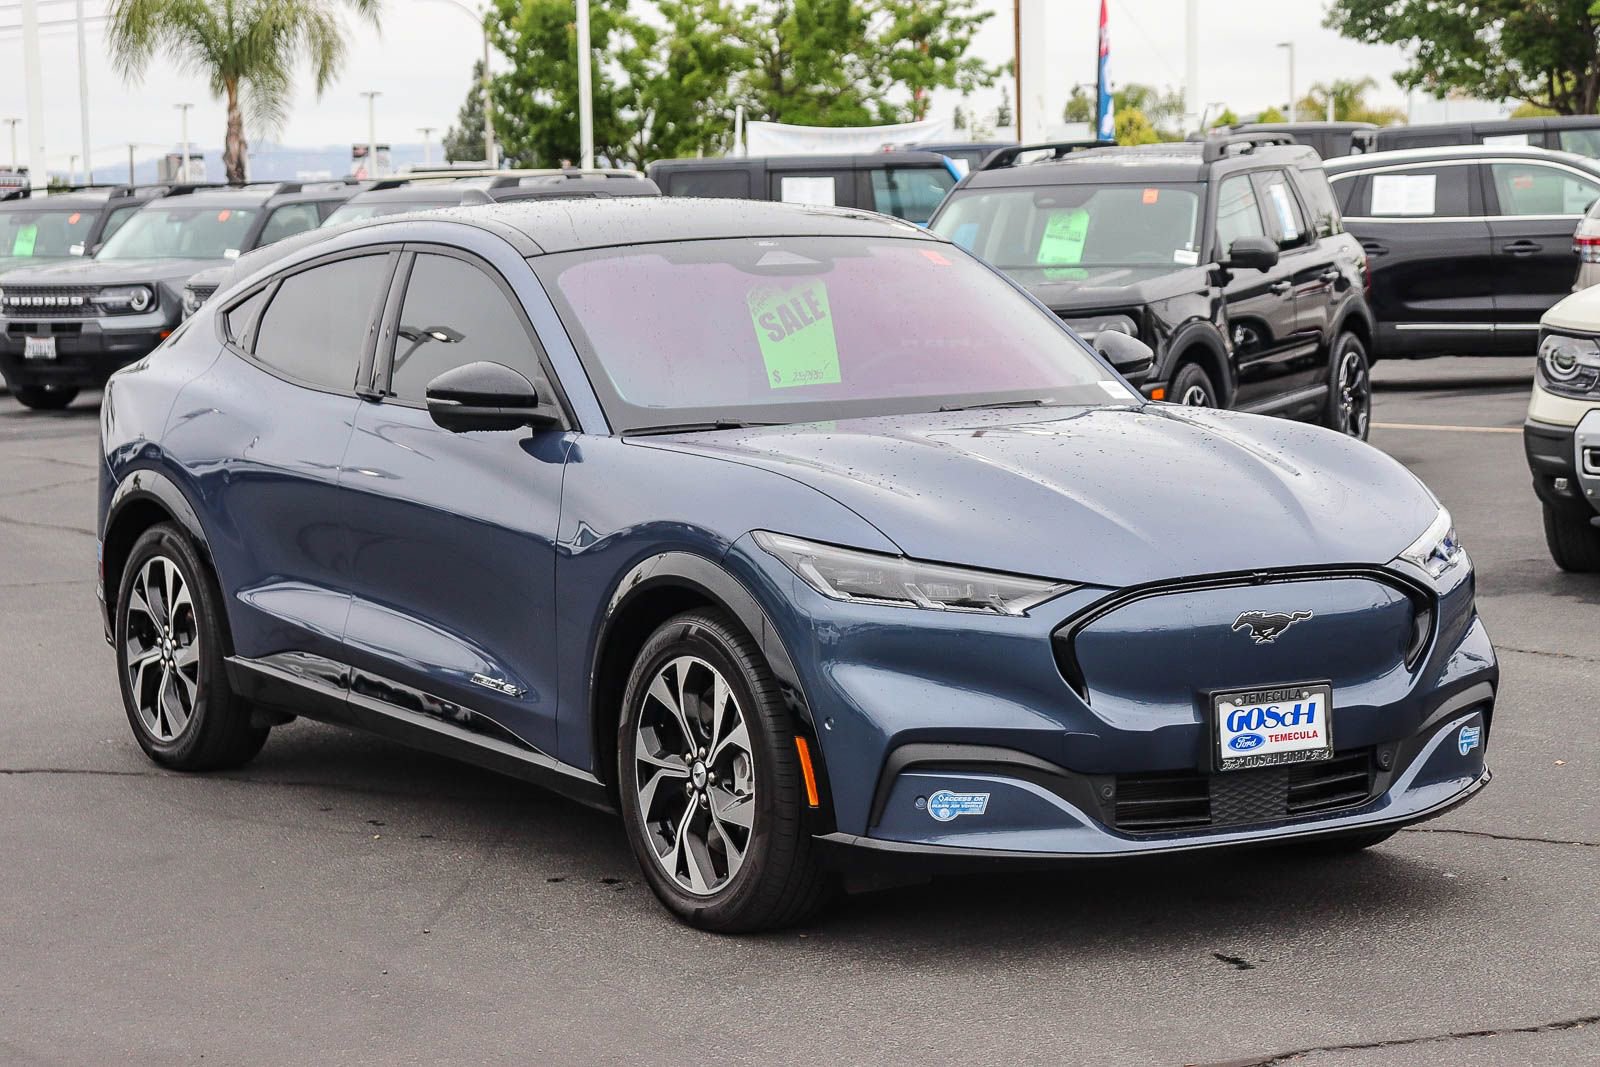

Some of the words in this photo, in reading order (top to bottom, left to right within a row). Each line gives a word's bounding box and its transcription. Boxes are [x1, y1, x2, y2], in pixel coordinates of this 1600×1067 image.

[10, 296, 84, 306] BRONCO
[759, 287, 826, 342] SALE
[773, 369, 782, 384] $
[1241, 689, 1302, 704] TEMECULA
[1235, 736, 1257, 749] Ford
[1268, 730, 1319, 743] TEMECULA
